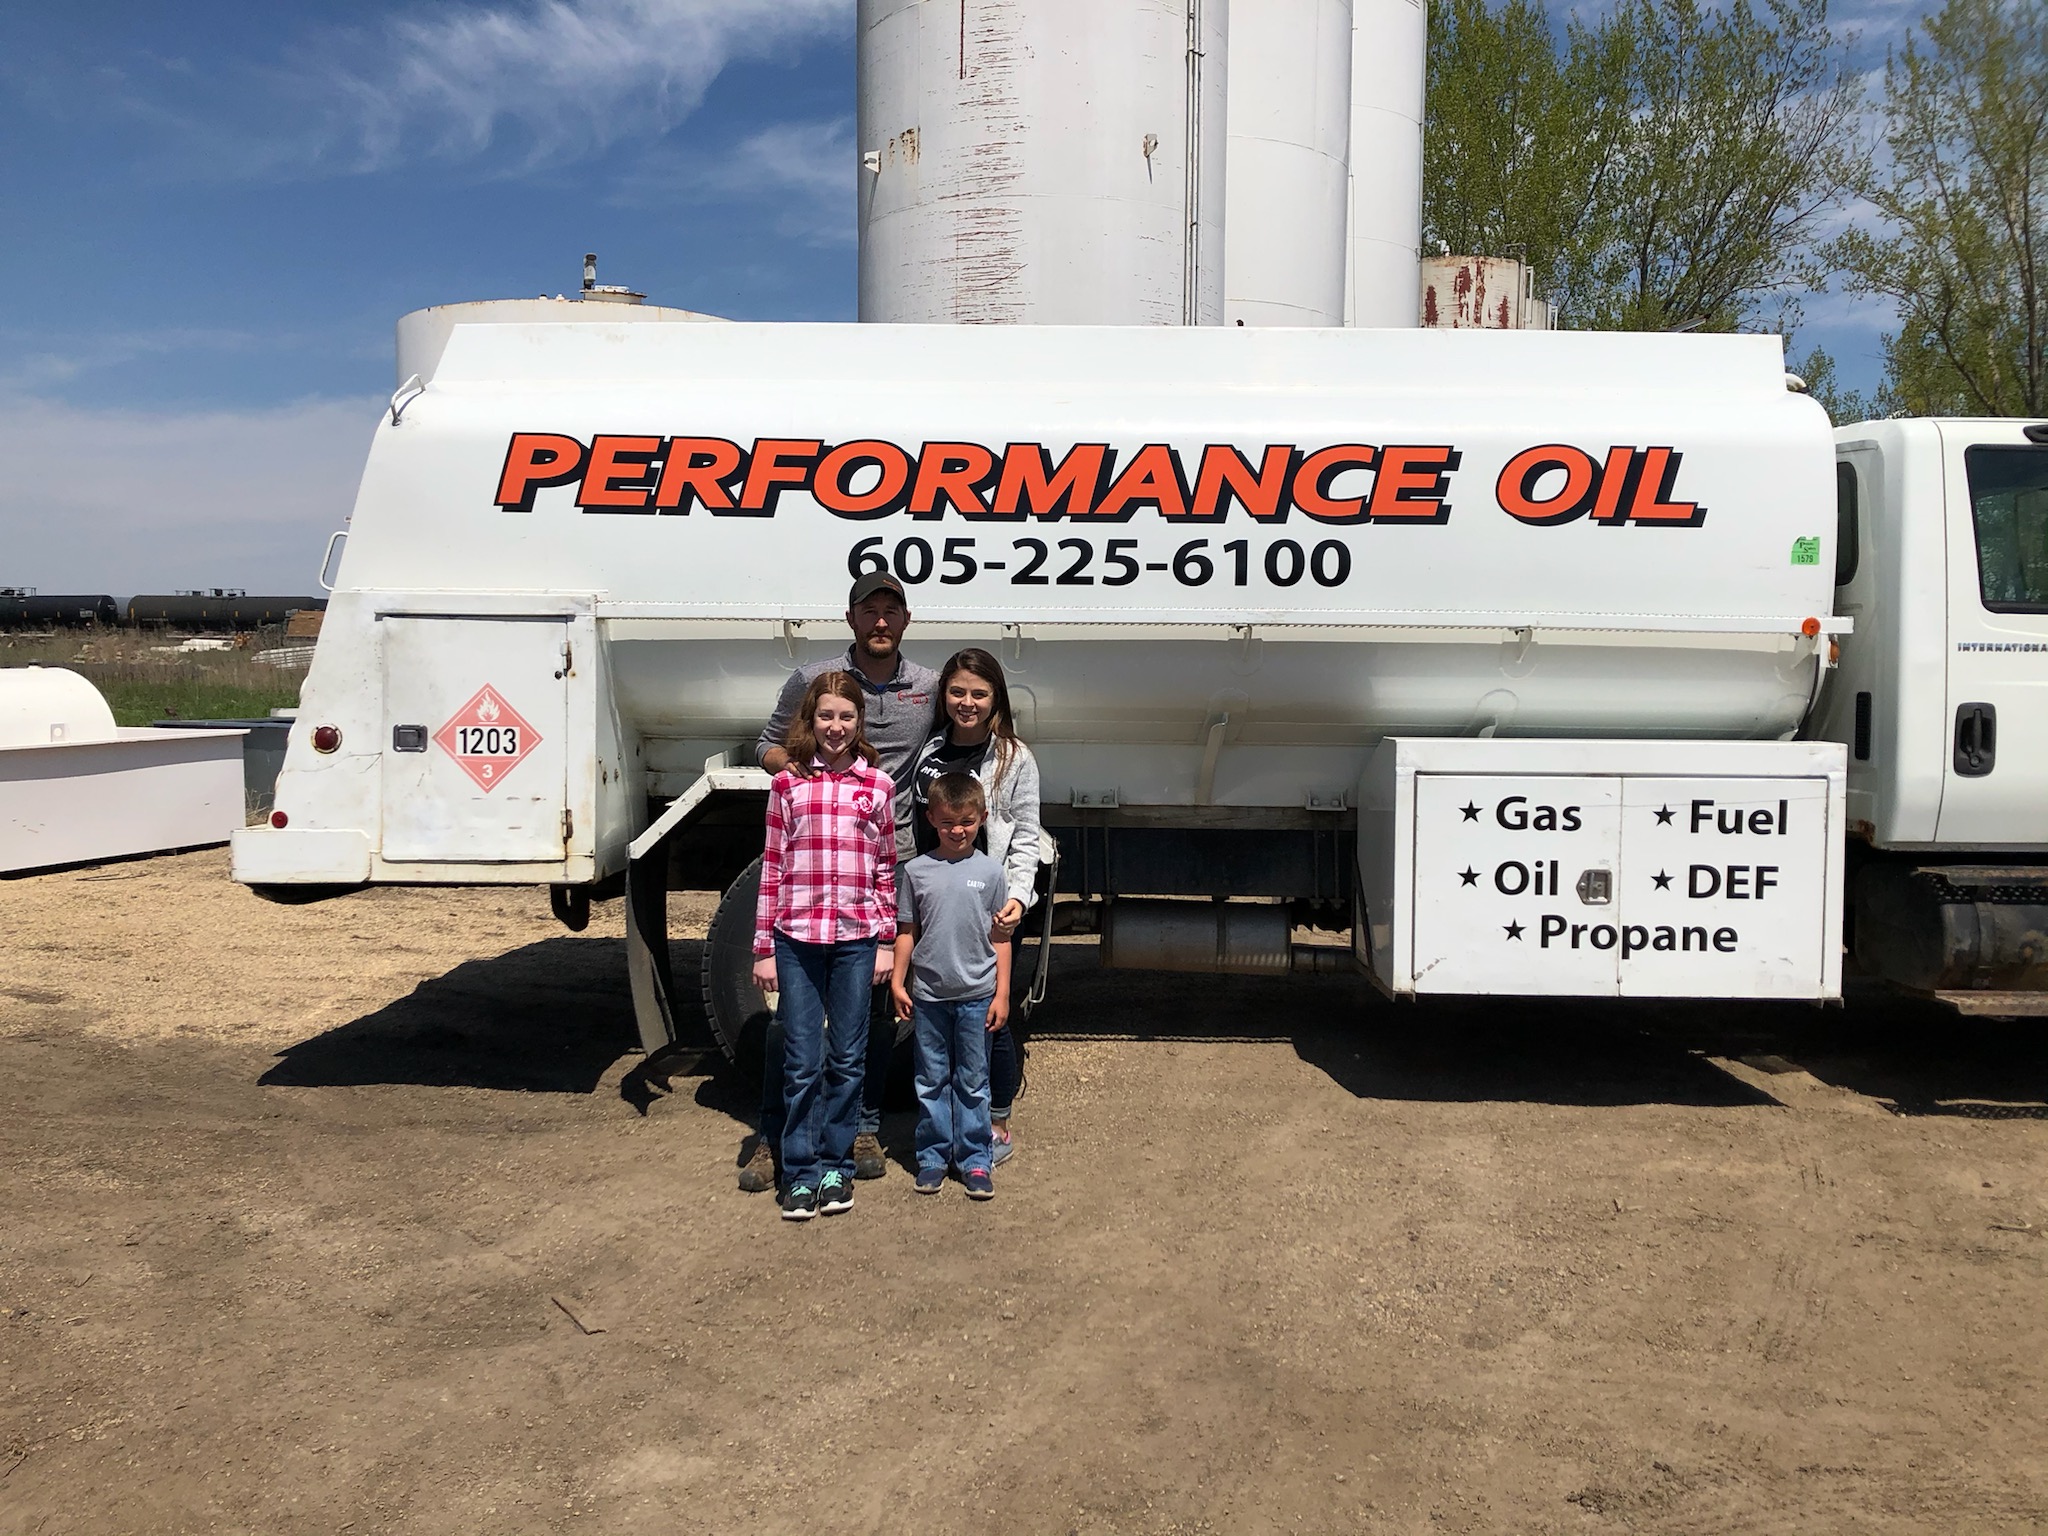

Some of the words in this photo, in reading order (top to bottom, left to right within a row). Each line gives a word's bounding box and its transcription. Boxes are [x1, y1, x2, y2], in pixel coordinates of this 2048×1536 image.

[493, 431, 1463, 526] PERFORMANCE
[1495, 443, 1708, 528] OIL
[848, 536, 1352, 587] 605-225-6100
[459, 728, 517, 754] 1203
[481, 764, 494, 779] 3
[1495, 795, 1582, 832] Gas
[1690, 799, 1788, 835] Fuel
[1494, 860, 1559, 896] Oil
[1688, 864, 1779, 900] DEF
[1540, 914, 1738, 960] Propane
